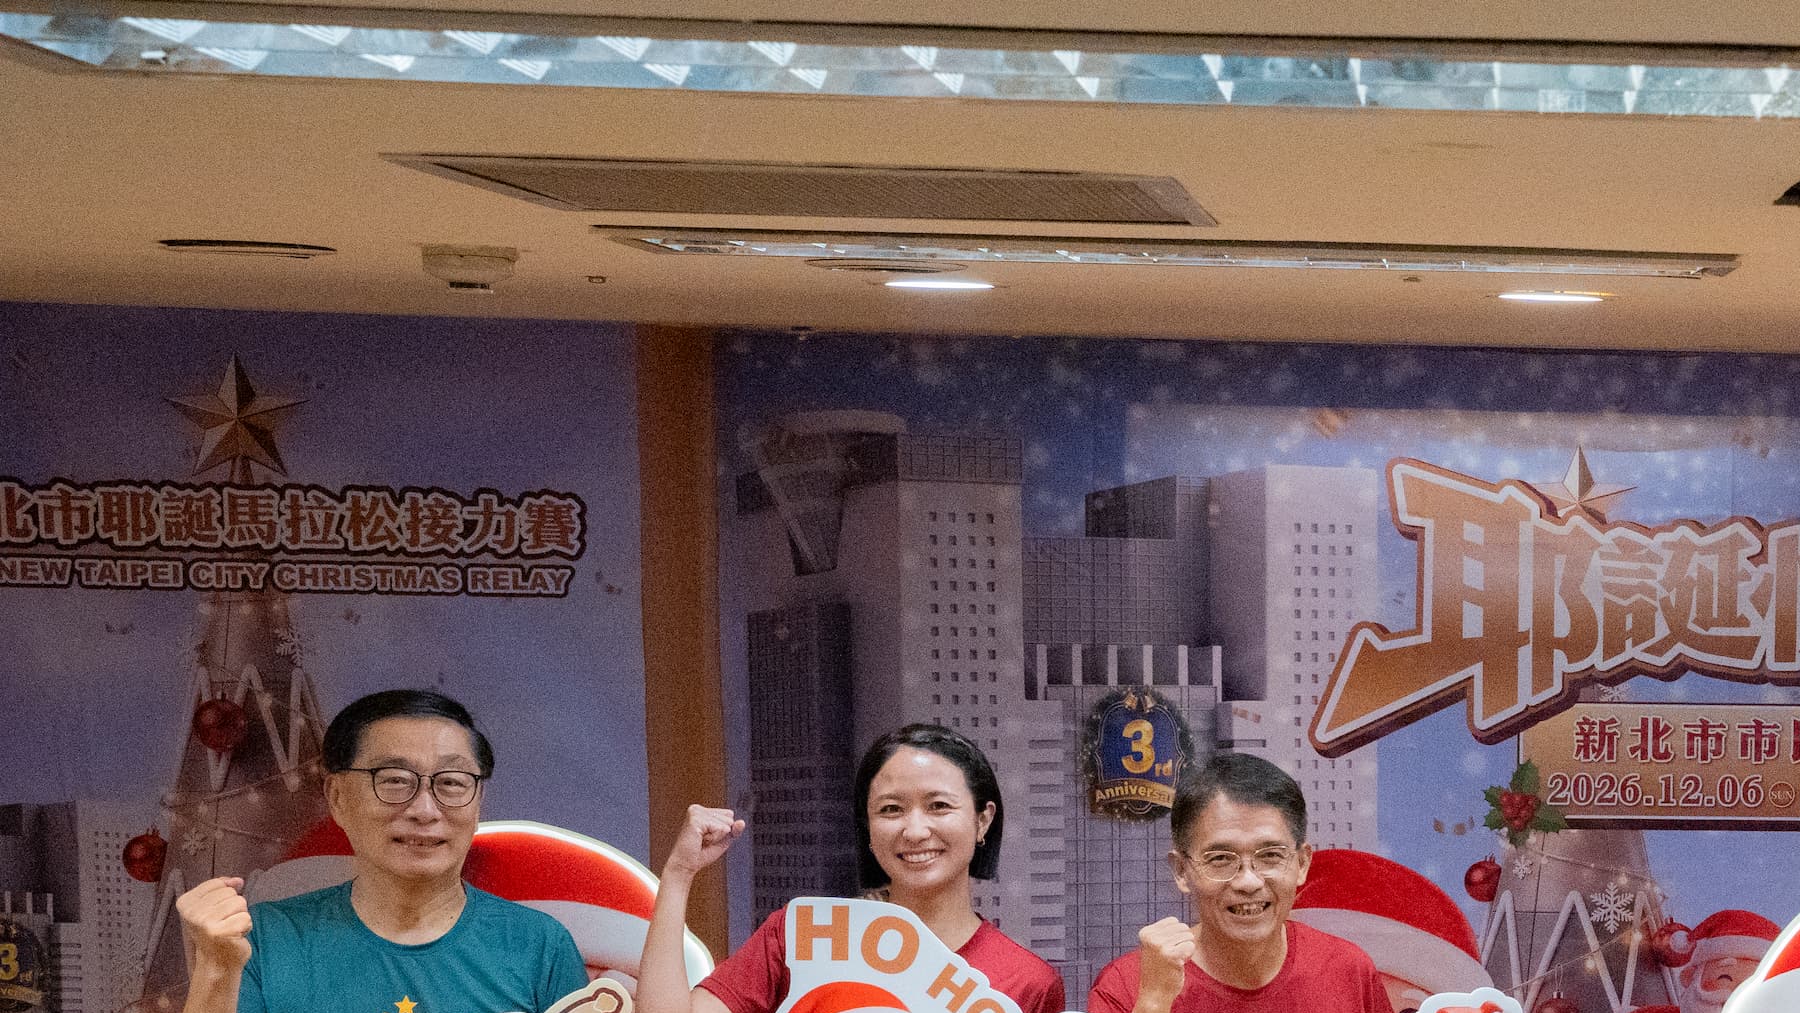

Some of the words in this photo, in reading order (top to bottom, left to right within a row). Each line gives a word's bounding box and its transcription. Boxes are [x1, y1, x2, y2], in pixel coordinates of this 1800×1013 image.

[0, 559, 69, 583] NEW
[77, 562, 182, 584] TAIPEI
[191, 563, 267, 588] CITY
[275, 565, 460, 590] CHRISTMAS
[470, 568, 570, 592] RELAY
[1095, 781, 1173, 803] Anniversa
[1547, 773, 1764, 808] 2026.12.06
[795, 905, 920, 974] HO
